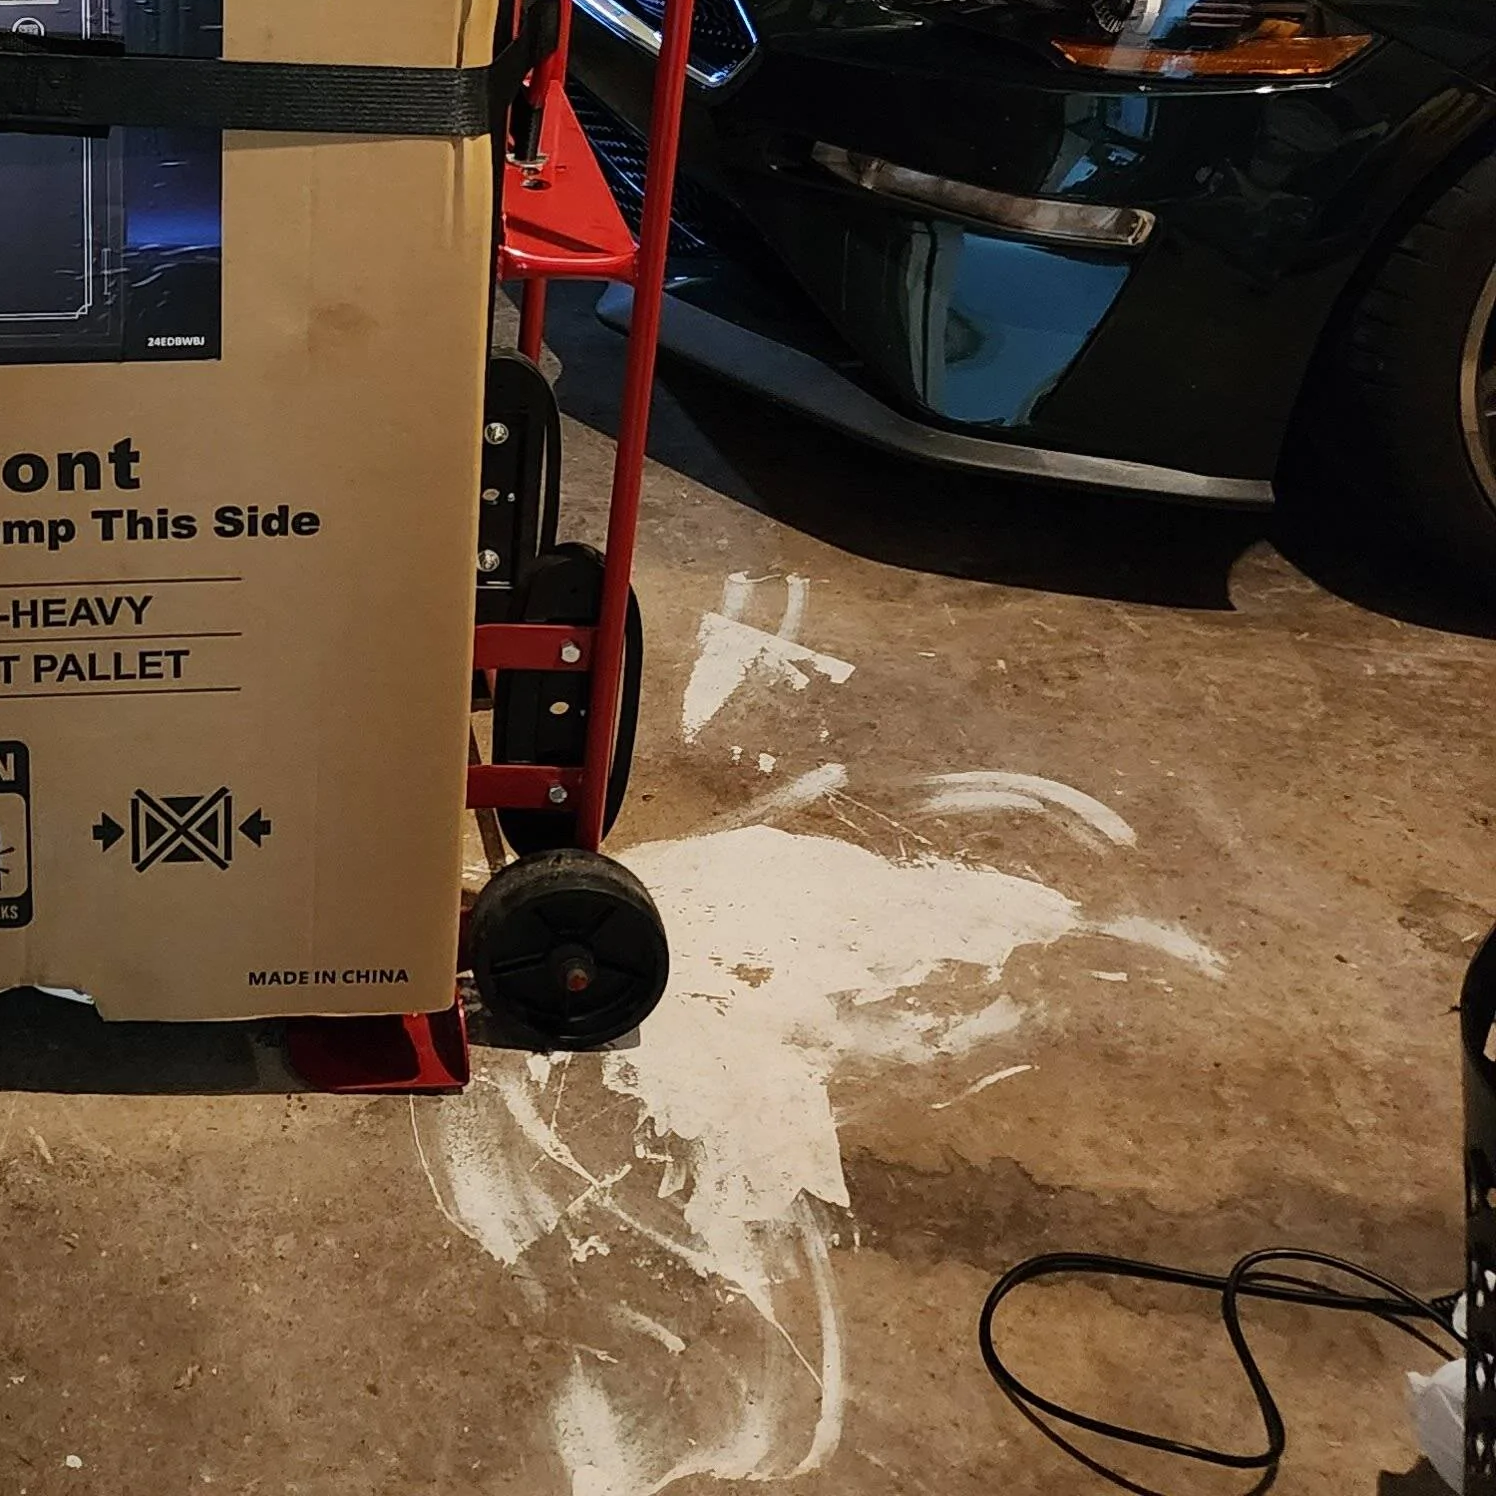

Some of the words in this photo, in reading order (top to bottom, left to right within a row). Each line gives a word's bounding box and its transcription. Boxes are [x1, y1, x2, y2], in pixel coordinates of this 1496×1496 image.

[147, 336, 205, 347] 24EDBWBJ
[91, 508, 197, 541] This
[213, 505, 321, 538] Side
[34, 650, 190, 683] PALLET
[249, 971, 309, 986] MADE
[315, 970, 336, 984] IN
[342, 969, 409, 984] CHINA
